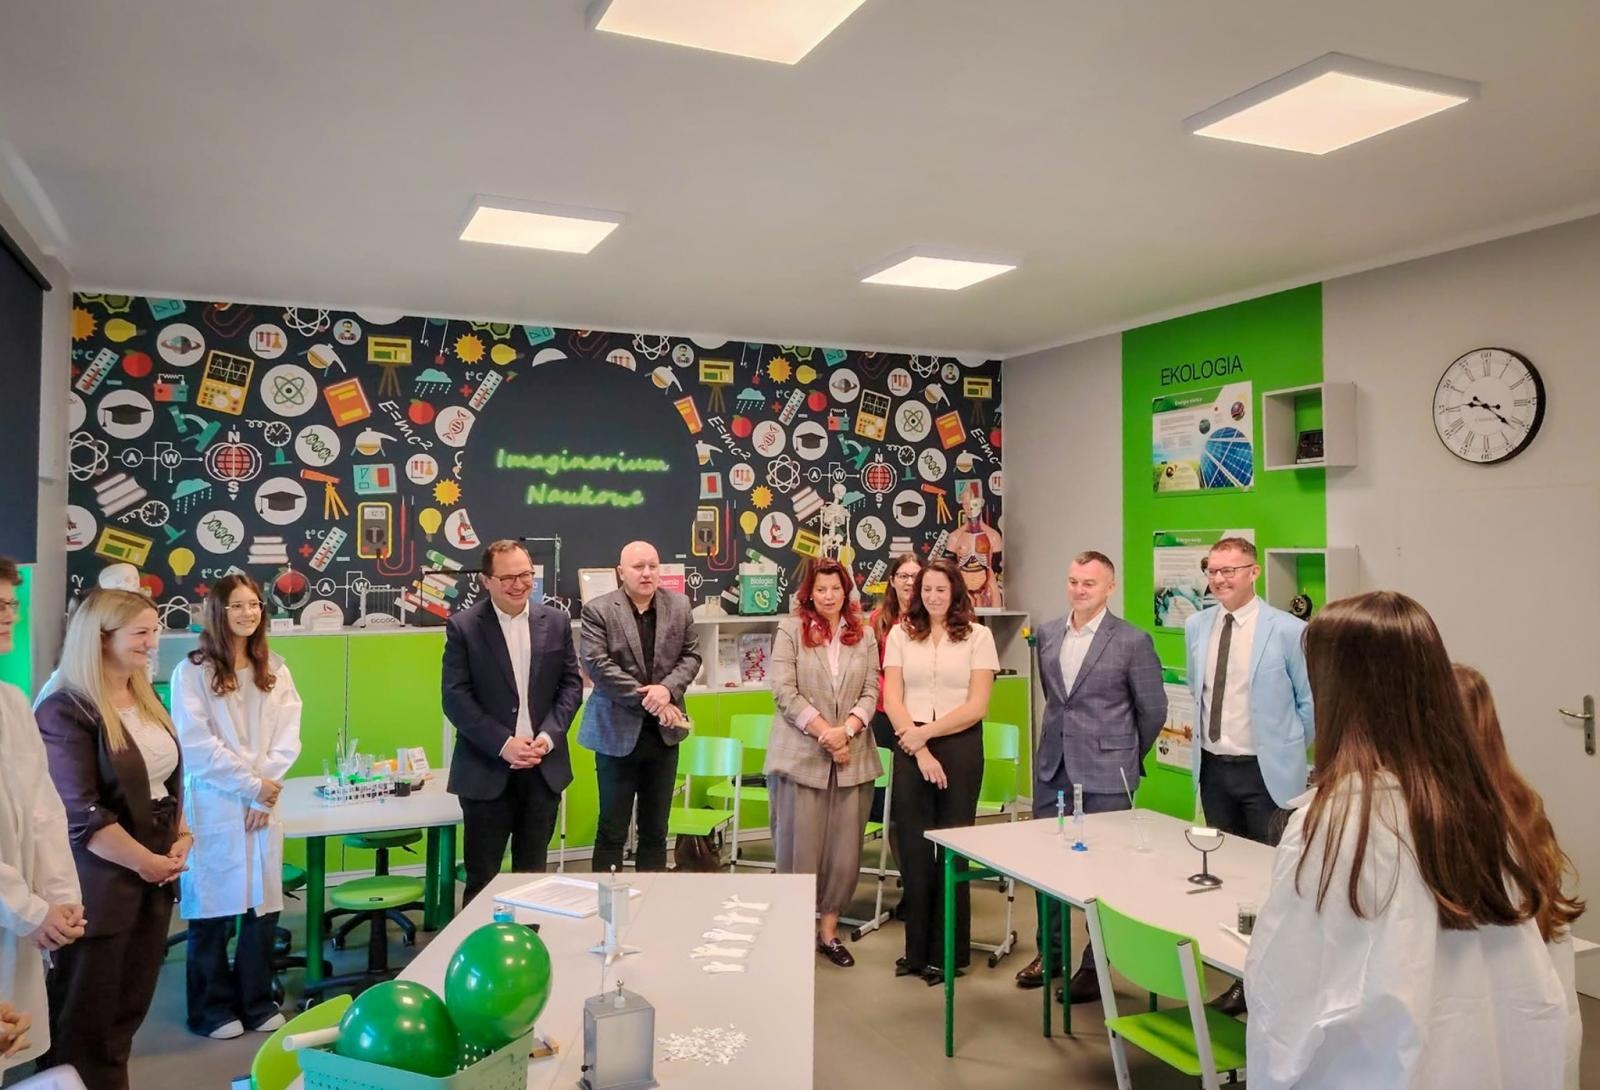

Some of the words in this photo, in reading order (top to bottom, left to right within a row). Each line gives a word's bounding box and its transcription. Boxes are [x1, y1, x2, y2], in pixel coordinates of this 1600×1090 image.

[1161, 355, 1243, 386] EKOLOGIA
[228, 431, 240, 443] N
[127, 452, 138, 463] A
[164, 453, 178, 464] W
[497, 449, 669, 475] Imaginarium
[875, 453, 883, 463] N
[811, 470, 819, 480] A
[835, 471, 844, 480] W
[227, 481, 239, 493] S
[527, 483, 644, 507] Naukowe
[876, 493, 883, 503] S
[690, 576, 701, 586] W
[751, 577, 774, 586] Biologia
[321, 582, 331, 592] A
